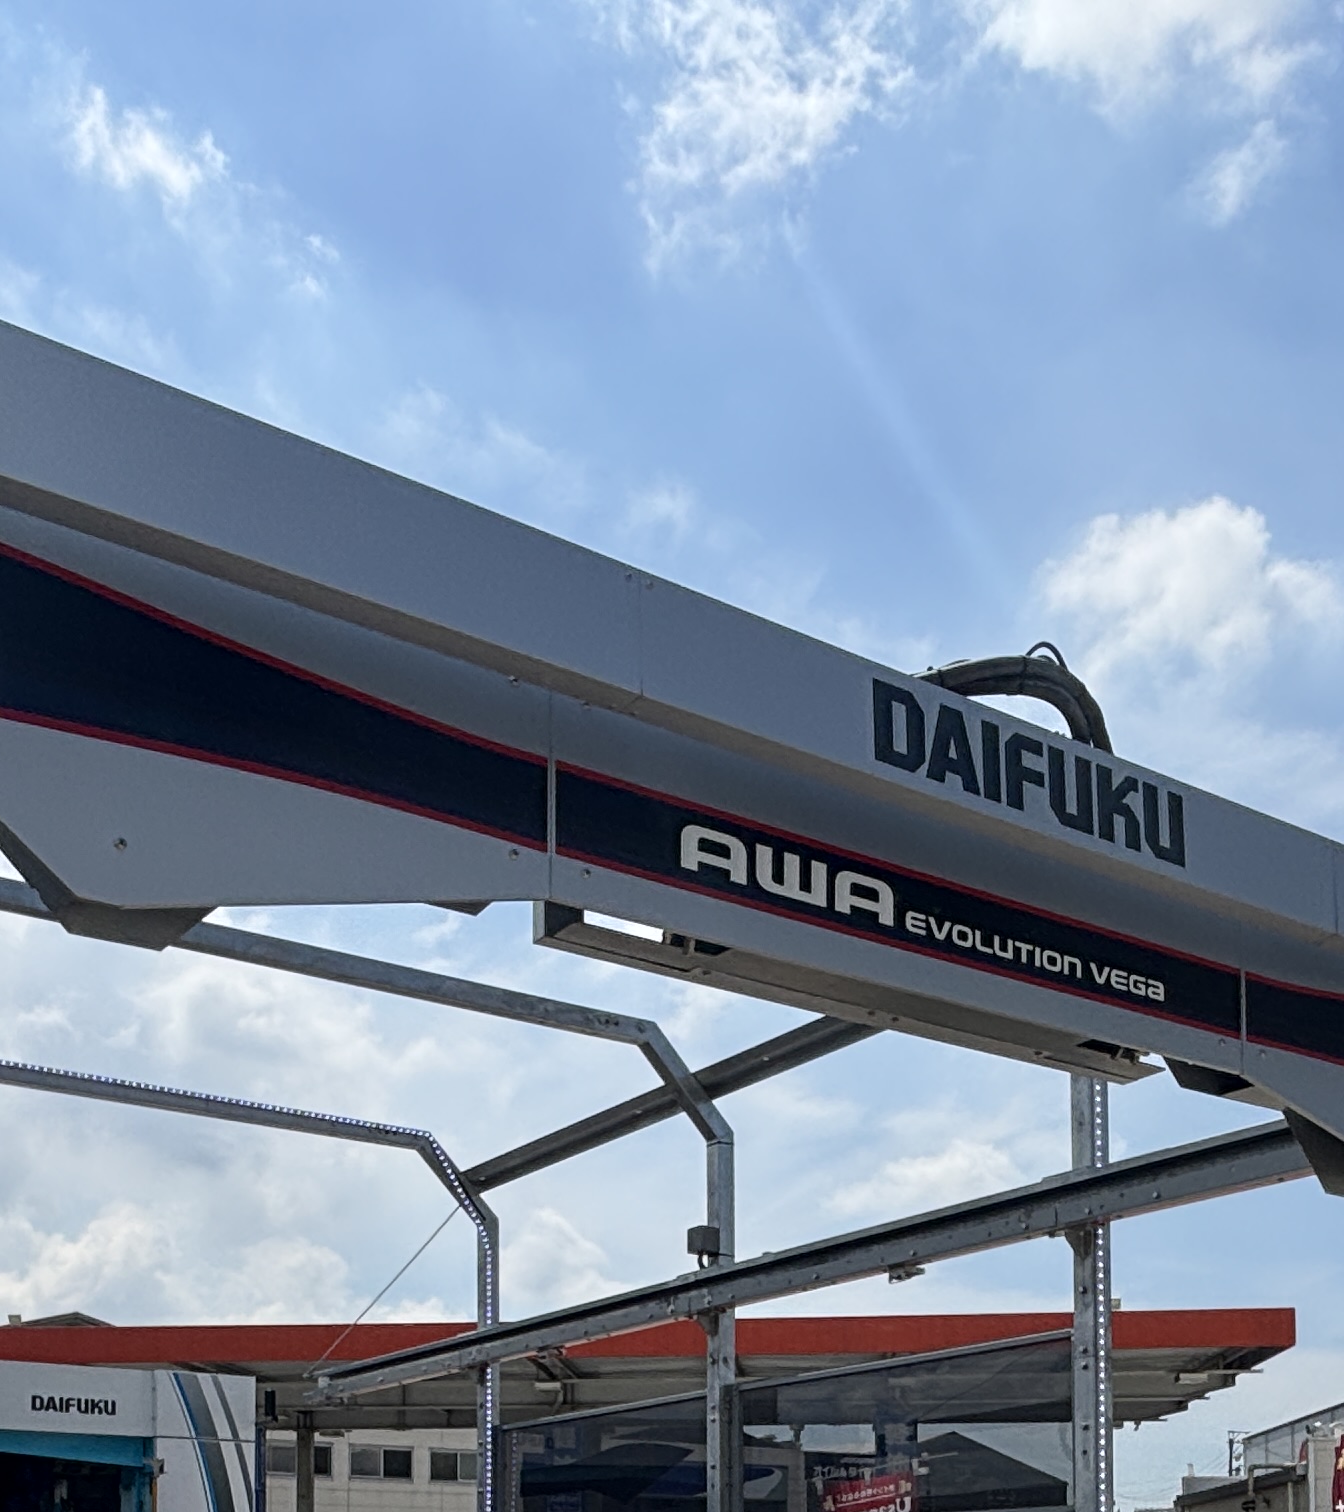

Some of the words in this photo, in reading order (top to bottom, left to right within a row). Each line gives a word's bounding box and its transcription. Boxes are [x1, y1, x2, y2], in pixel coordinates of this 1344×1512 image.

[872, 677, 1186, 868] DAIFUKU
[679, 824, 895, 927] AWA
[905, 910, 1082, 980] EVOLUTION
[31, 1395, 116, 1416] DAIFUKU
